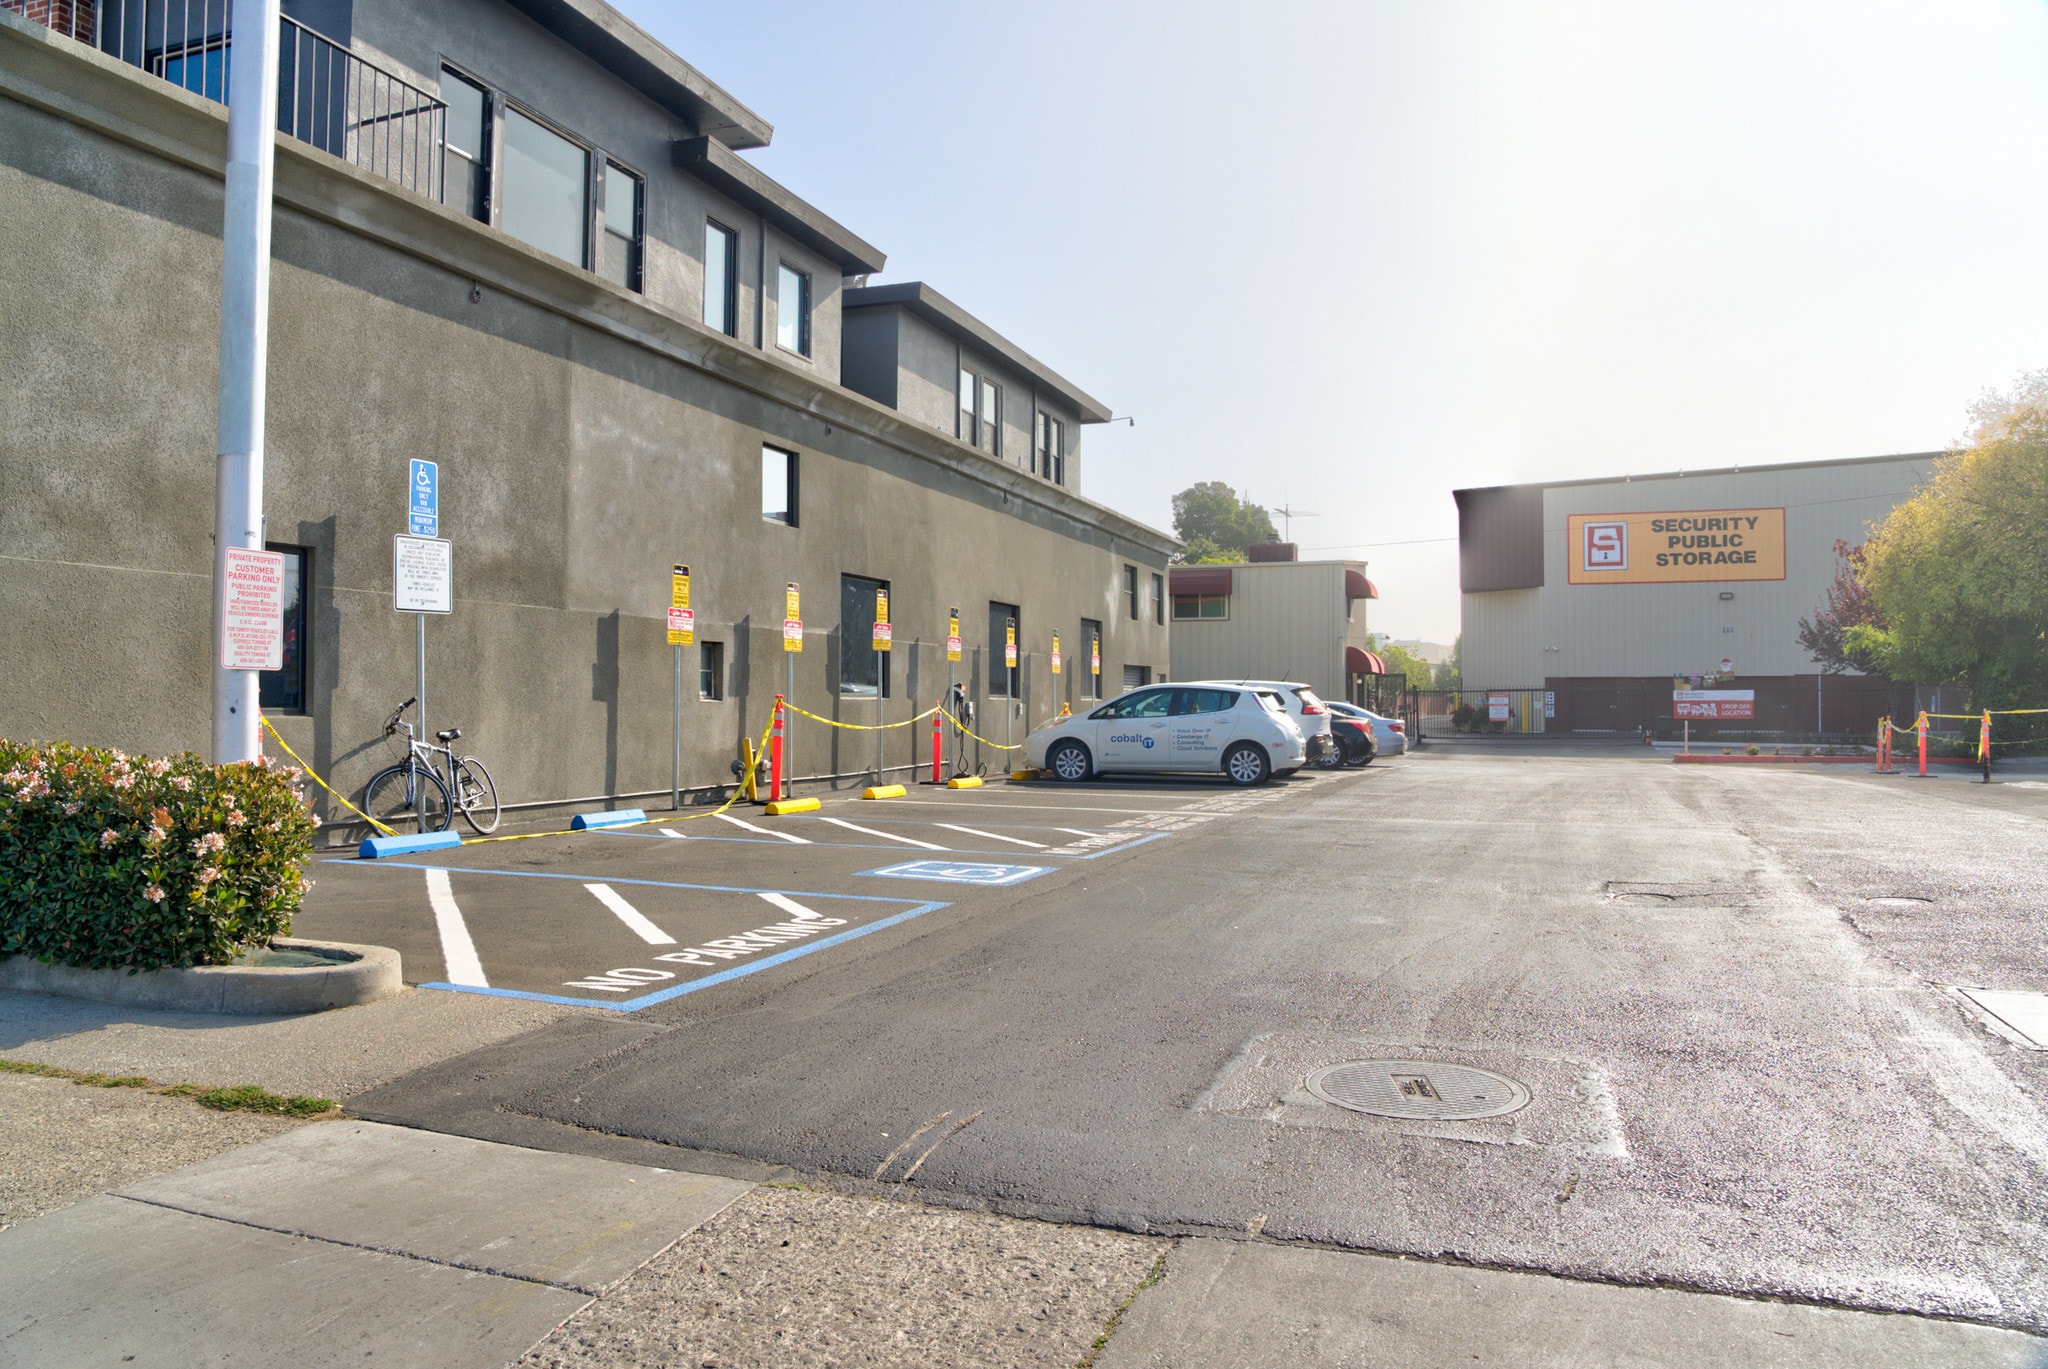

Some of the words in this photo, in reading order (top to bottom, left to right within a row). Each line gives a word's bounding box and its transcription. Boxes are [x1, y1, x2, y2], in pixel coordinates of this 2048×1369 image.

[1651, 516, 1759, 532] SECURITY
[1668, 534, 1743, 548] PUBLIC
[229, 553, 252, 562] PRIVATE
[253, 556, 281, 565] PROPERTY
[1656, 550, 1757, 566] STORAGE
[235, 564, 274, 575] CUSTOMER
[228, 572, 260, 581] PARKING
[262, 576, 280, 584] ONLY
[238, 591, 271, 599] PROHIBITED
[1110, 734, 1143, 743] cobalt
[562, 968, 676, 992] NO
[653, 916, 848, 966] PARKING
